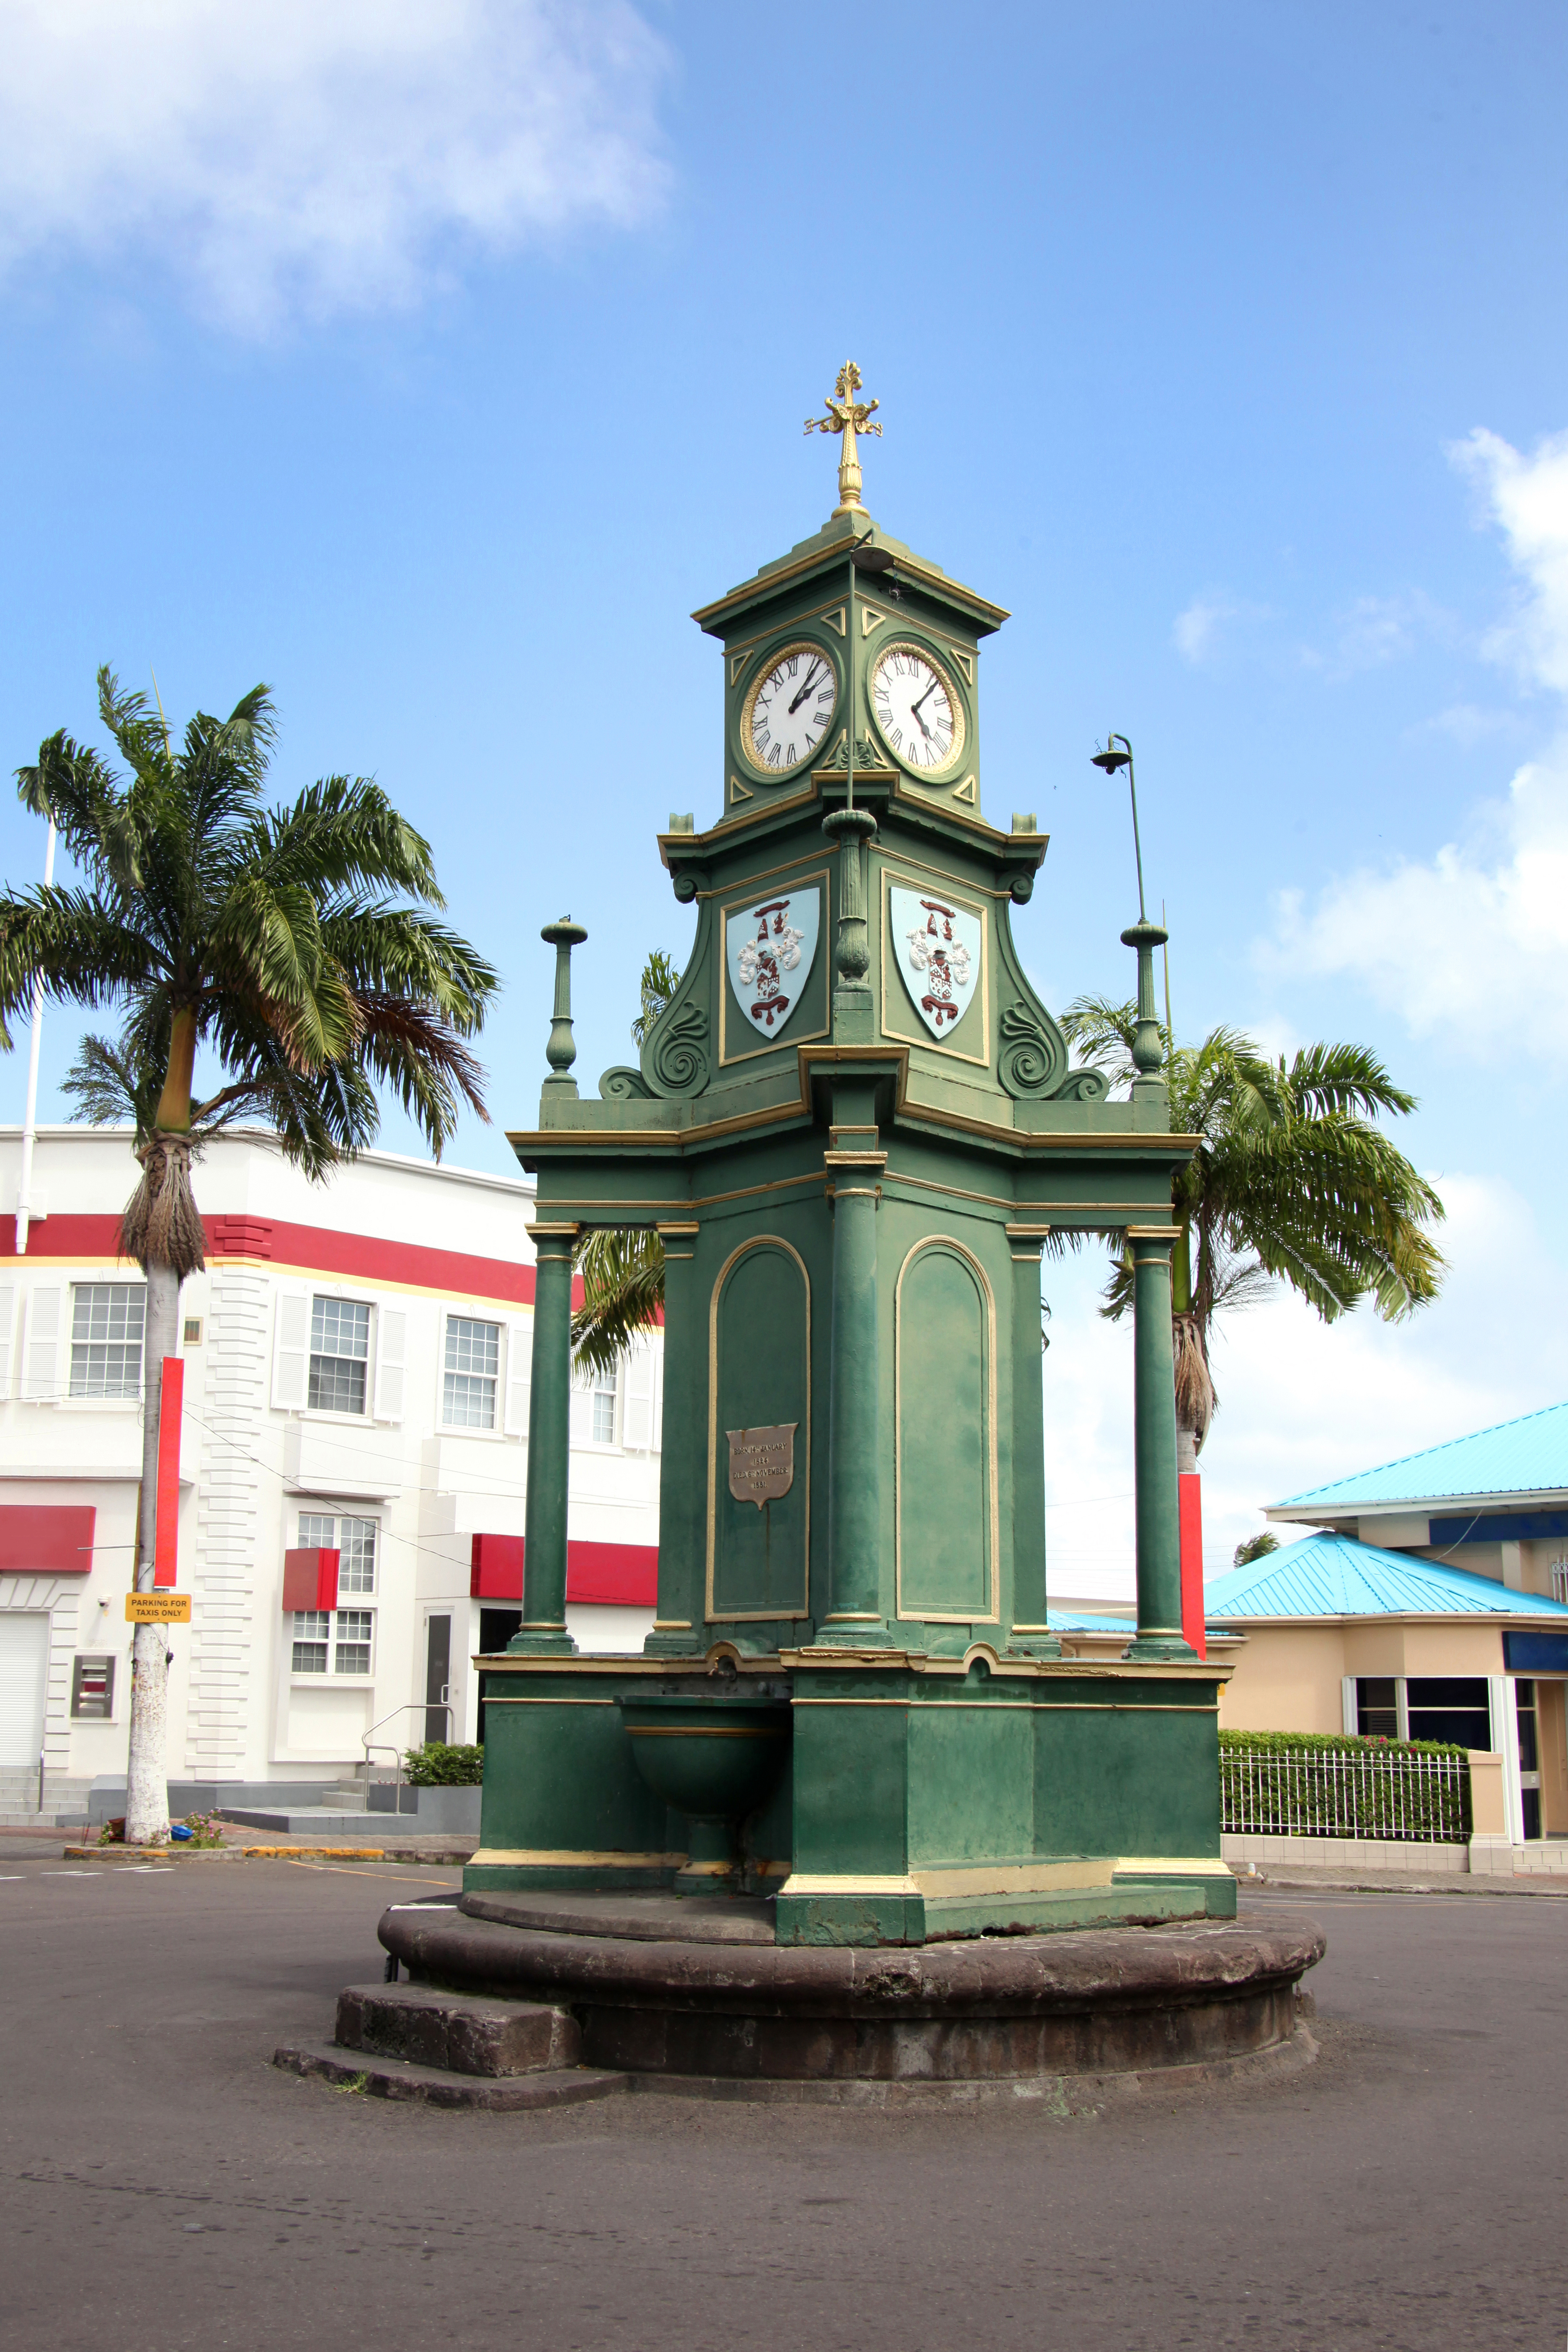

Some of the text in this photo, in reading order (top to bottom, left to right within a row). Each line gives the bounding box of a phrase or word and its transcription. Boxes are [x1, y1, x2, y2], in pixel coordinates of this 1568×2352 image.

[786, 655, 799, 679] XII
[880, 665, 893, 686] X
[891, 655, 905, 676] XI
[906, 656, 919, 678] XII
[769, 668, 784, 692] XI
[758, 693, 771, 709] X
[818, 689, 833, 704] III
[934, 698, 948, 707] II
[754, 716, 768, 731] IX
[878, 710, 894, 730] VIII
[937, 717, 952, 732] III
[756, 730, 771, 753] VIII
[891, 728, 903, 750] VII
[768, 743, 781, 765] VII
[787, 743, 797, 764] VI
[909, 743, 918, 764] VI
[925, 743, 936, 765] V
[761, 1443, 787, 1452] JANUARY
